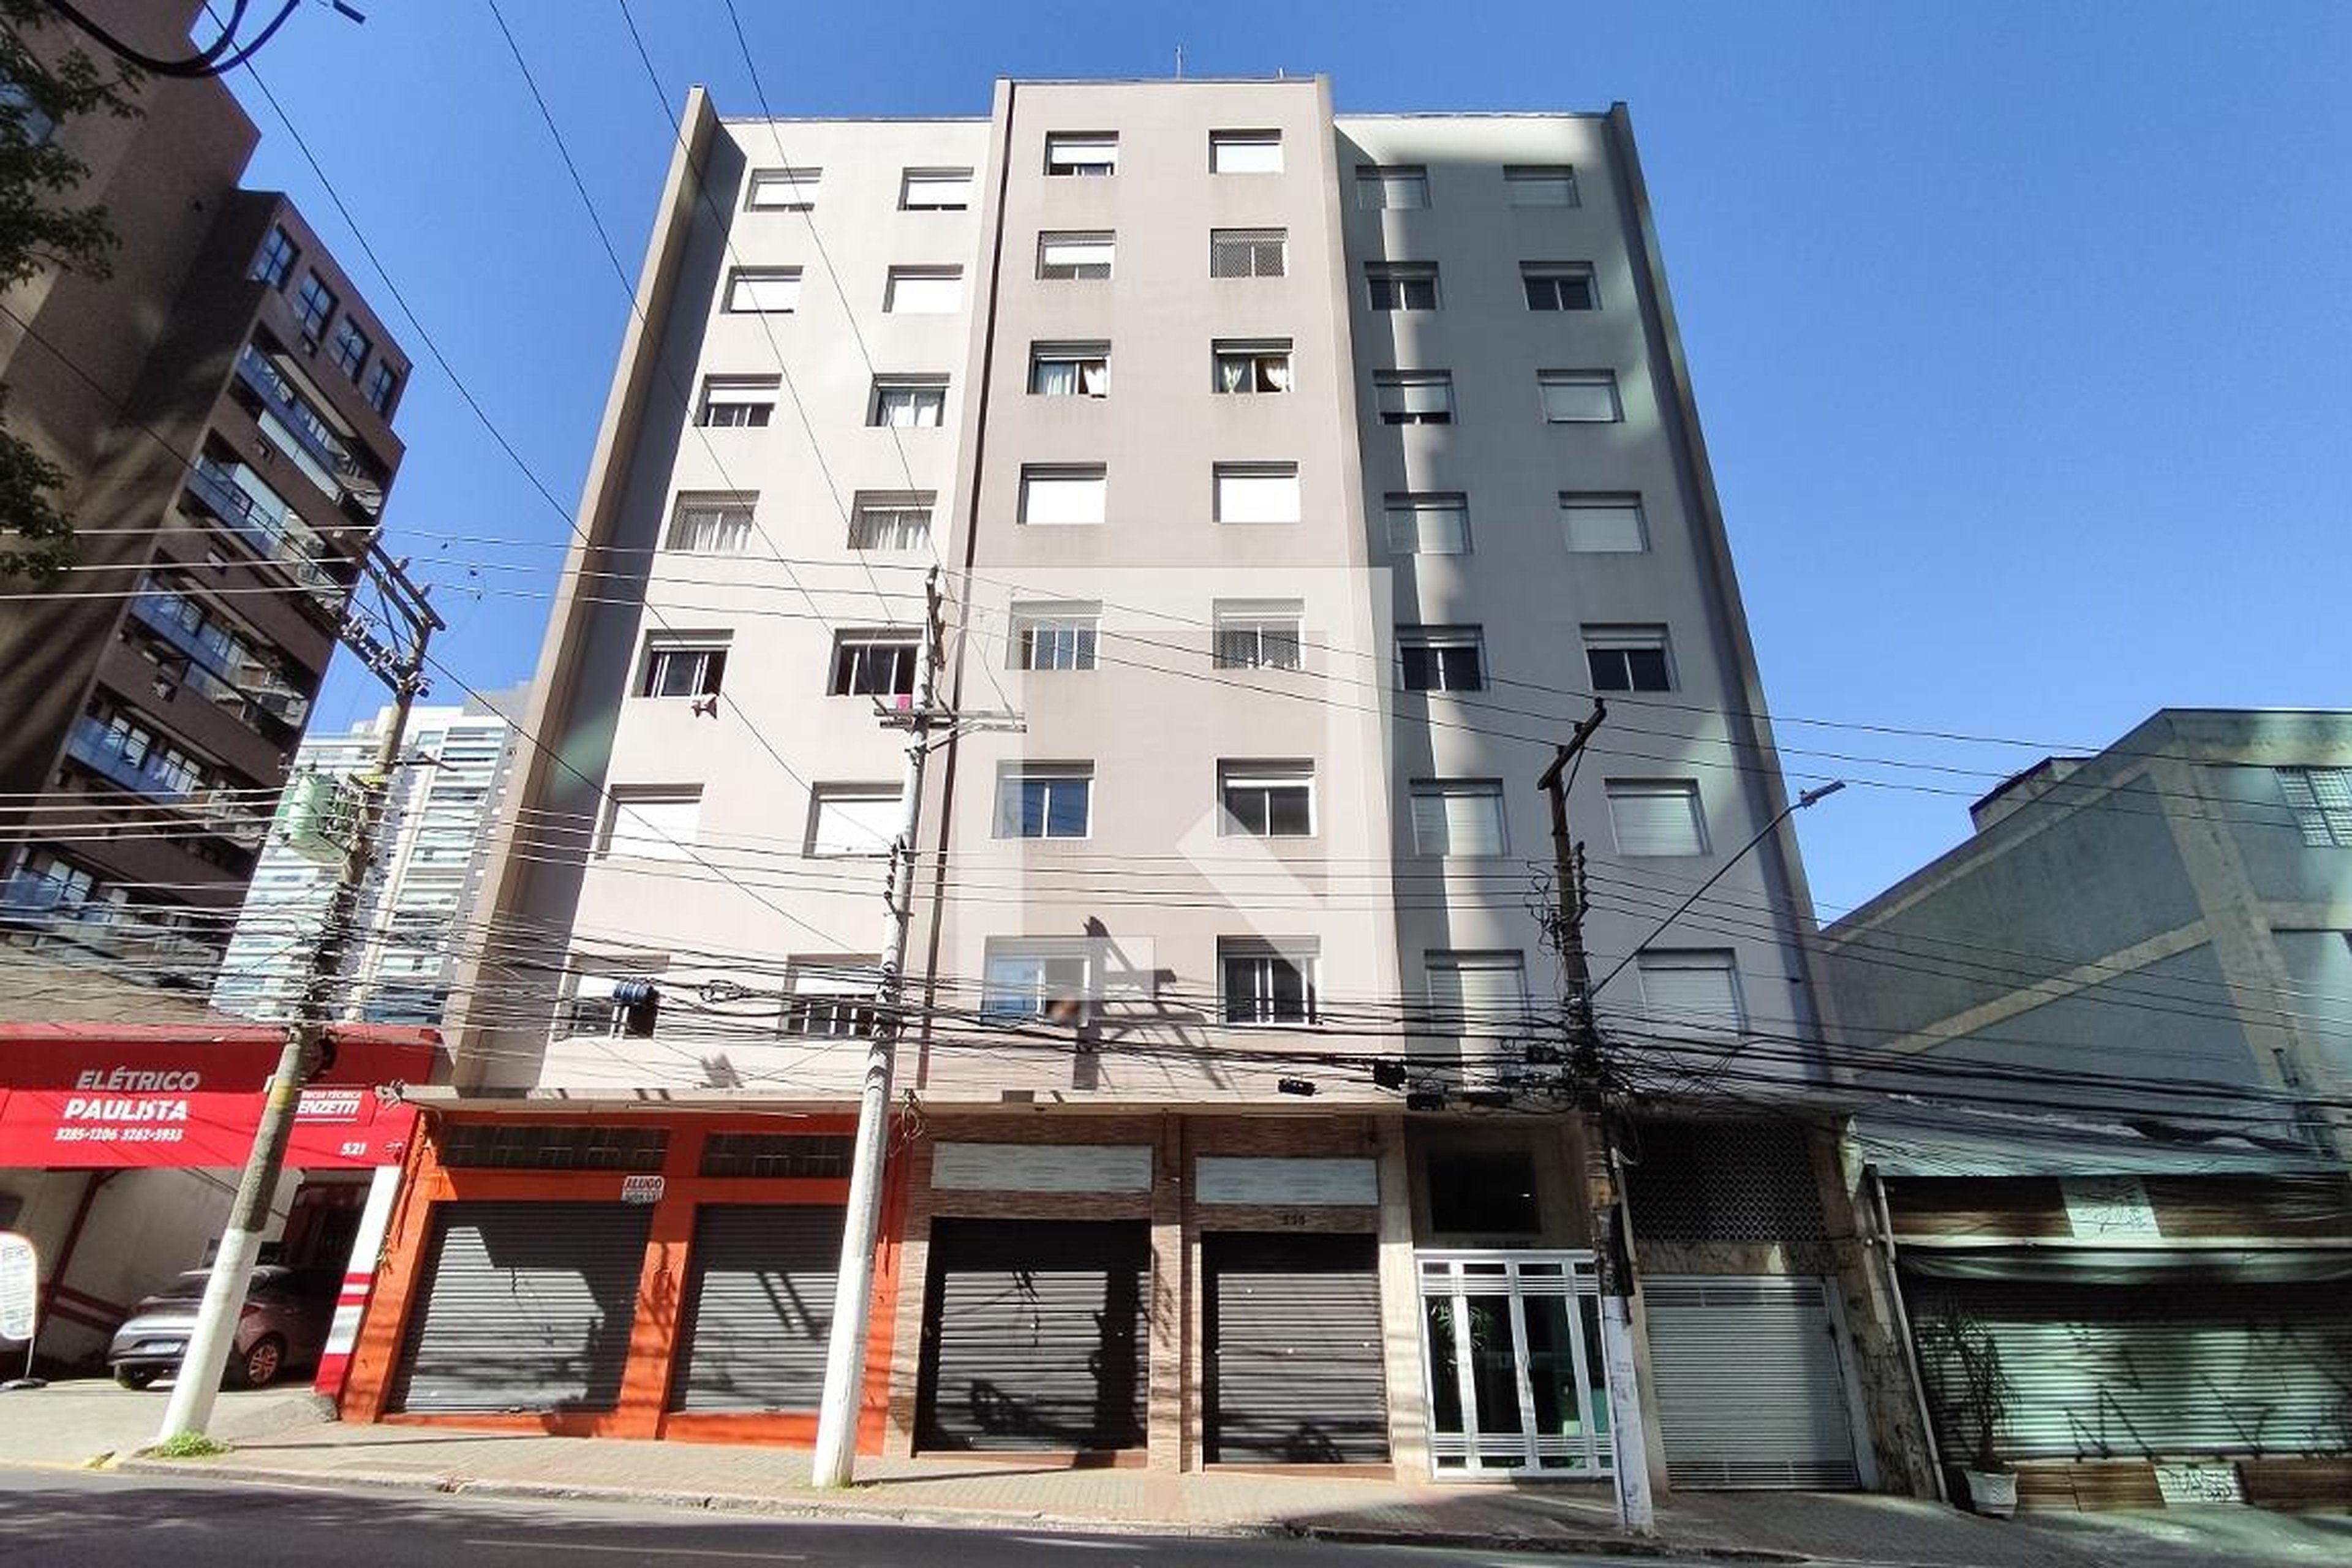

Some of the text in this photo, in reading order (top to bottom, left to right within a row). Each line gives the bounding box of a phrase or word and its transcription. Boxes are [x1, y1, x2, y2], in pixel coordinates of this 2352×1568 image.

[75, 1065, 200, 1091] ELÉTRICO
[64, 1098, 187, 1120] PAULISTA
[296, 1100, 360, 1114] ENZETTI
[341, 1142, 367, 1155] 521
